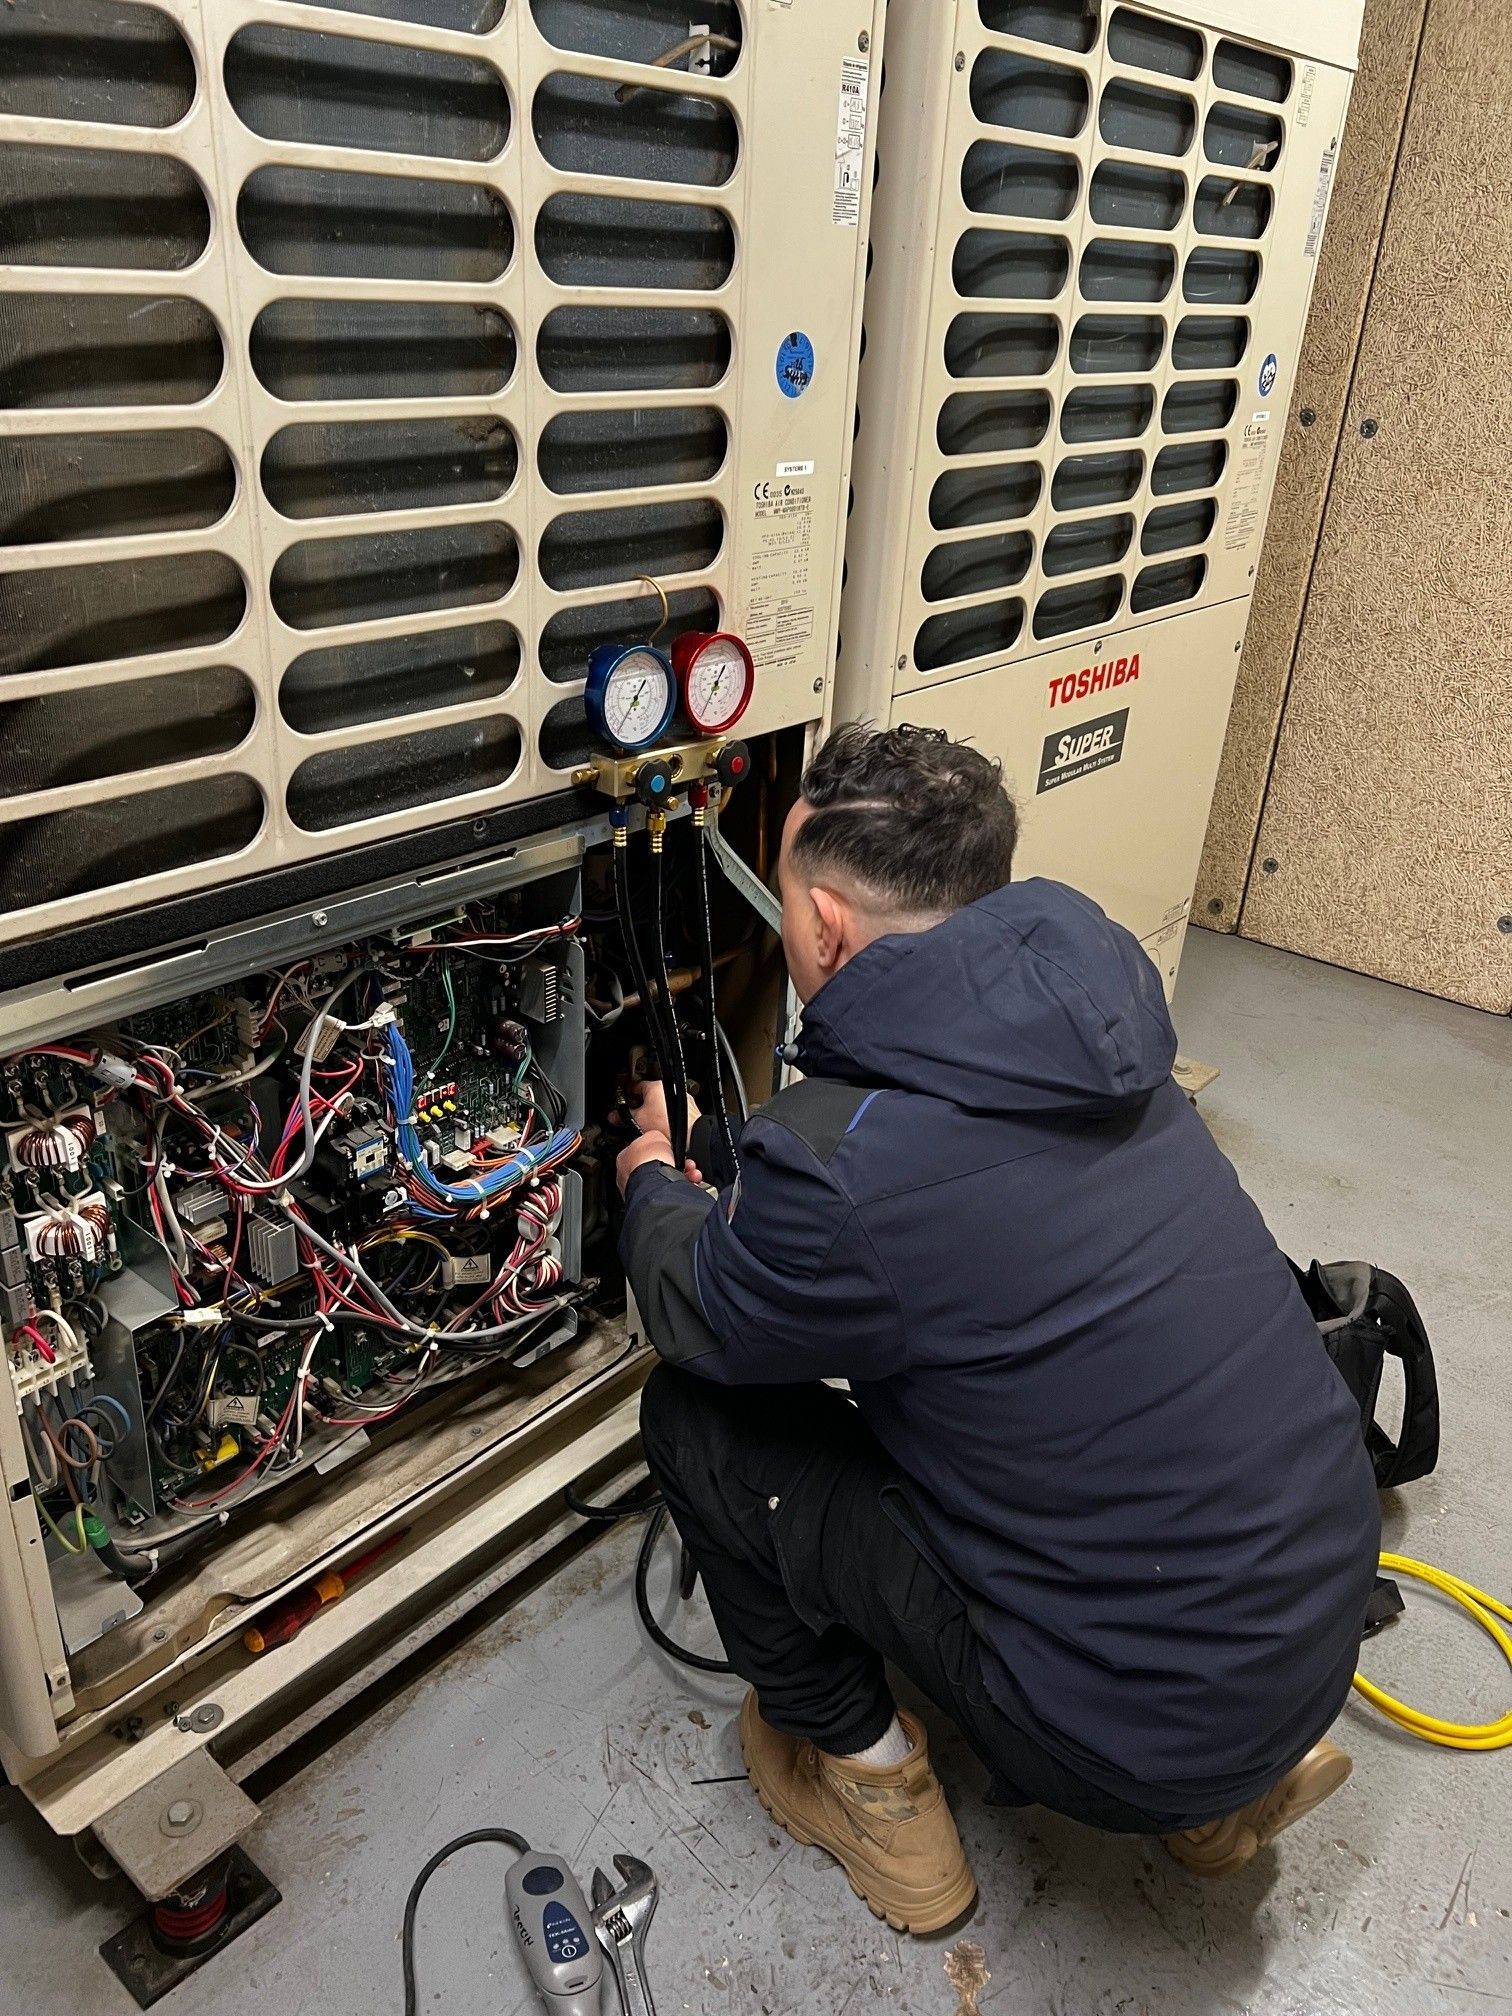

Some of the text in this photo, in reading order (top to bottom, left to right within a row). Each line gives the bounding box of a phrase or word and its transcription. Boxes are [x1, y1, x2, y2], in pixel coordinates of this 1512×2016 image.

[841, 84, 859, 94] R410A
[754, 482, 769, 500] CE
[756, 500, 773, 509] TOSHIBA
[785, 496, 811, 506] CONDITIONER
[1049, 654, 1139, 708] TOSHIBA
[1054, 725, 1114, 768] SUPER
